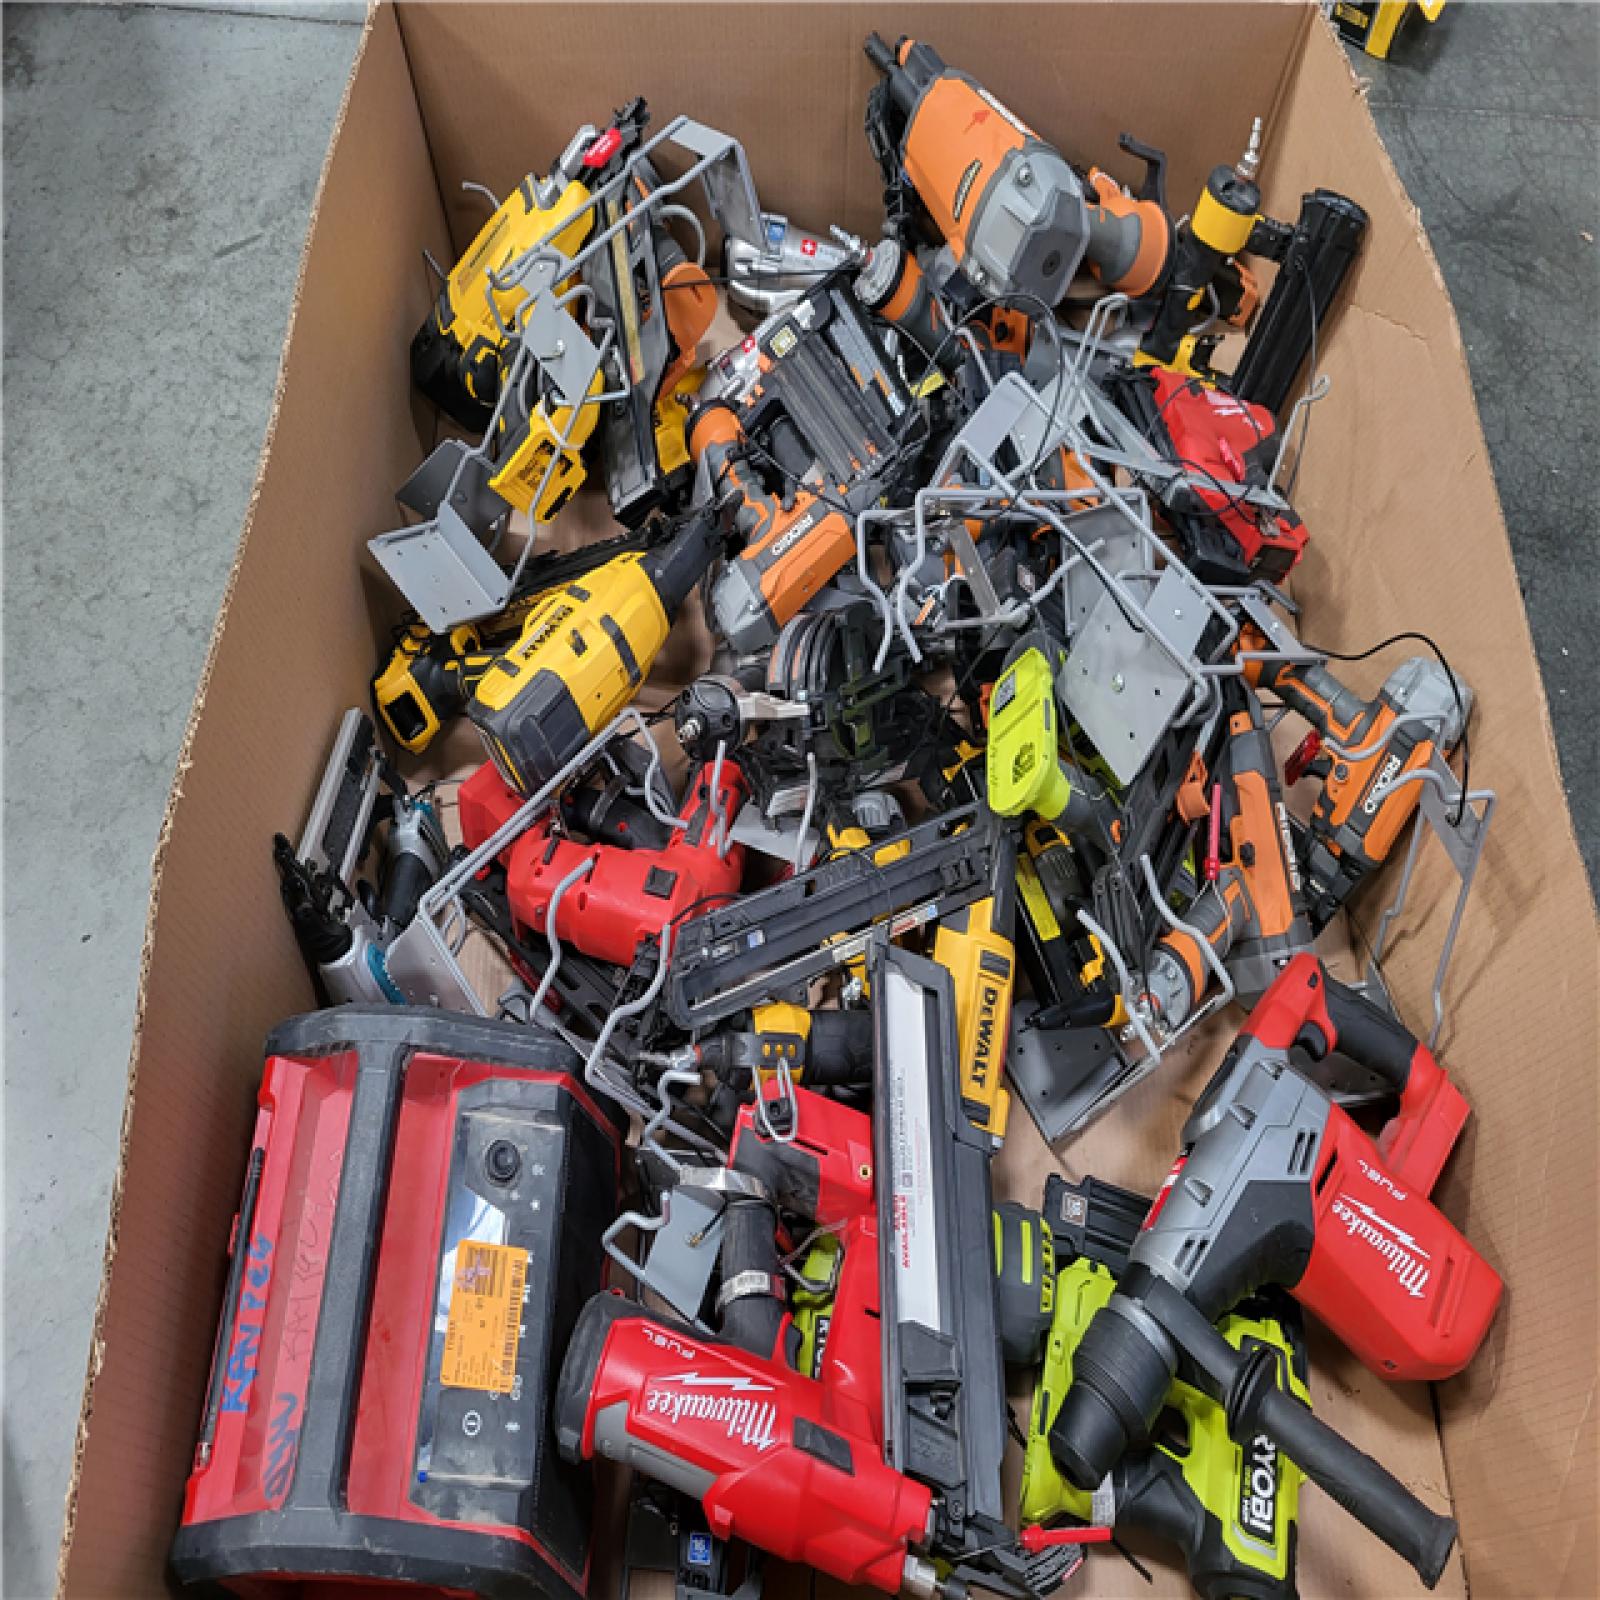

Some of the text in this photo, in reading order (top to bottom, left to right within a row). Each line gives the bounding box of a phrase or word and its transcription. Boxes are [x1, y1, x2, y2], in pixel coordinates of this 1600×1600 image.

[1332, 1199, 1430, 1298] Milwaukee
[642, 1327, 696, 1360] FUEL
[646, 1388, 777, 1453] Milwaukee
